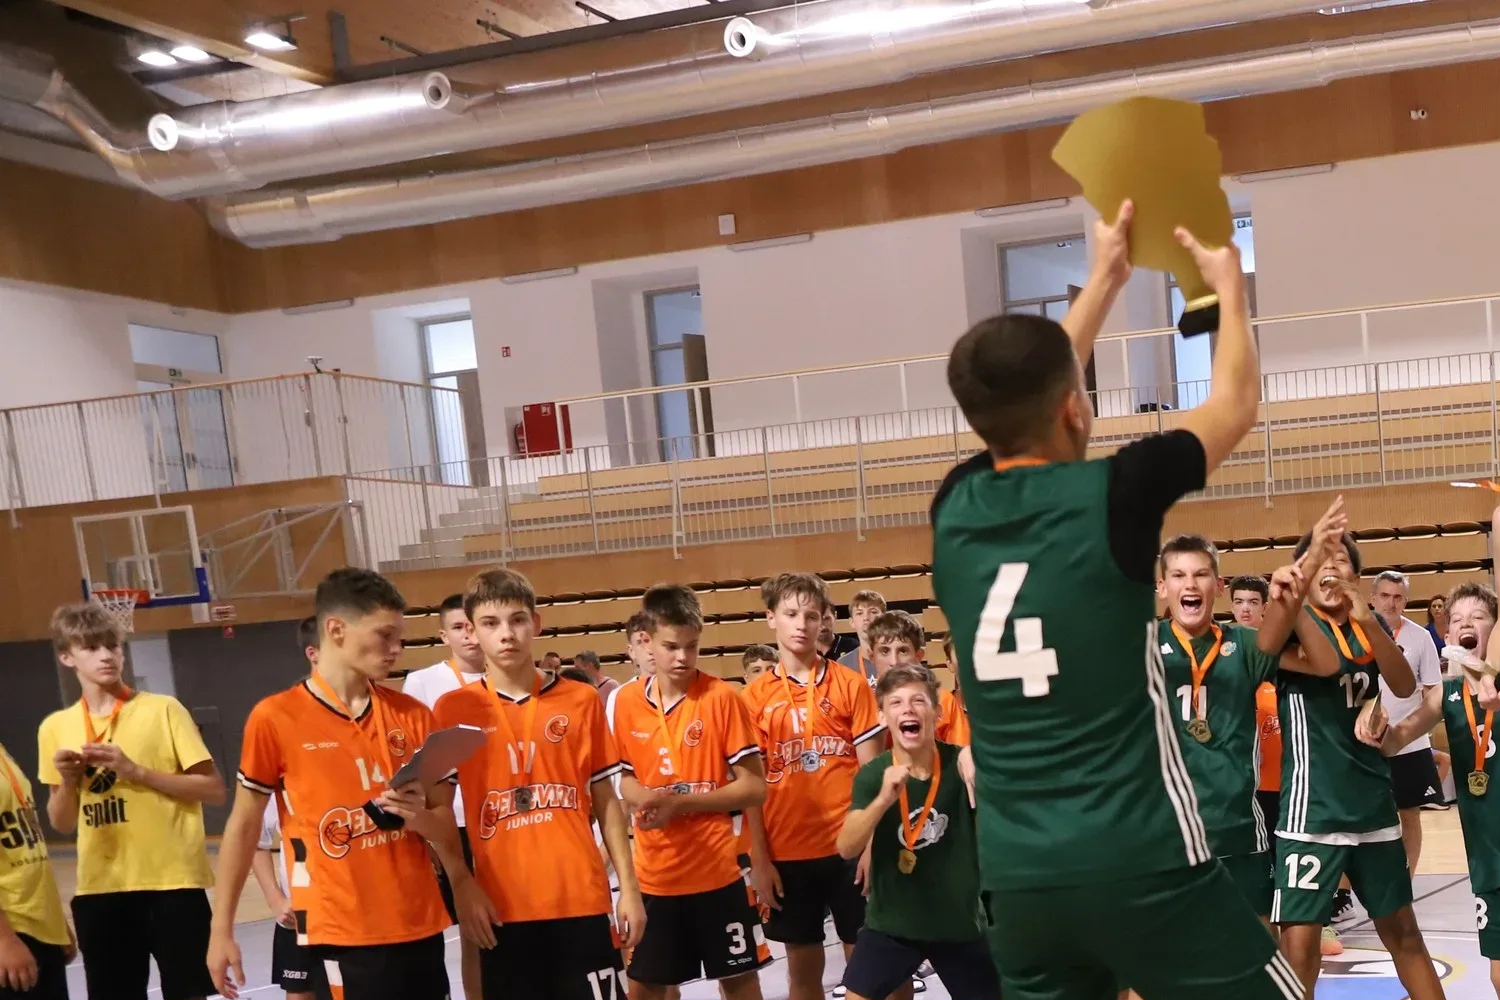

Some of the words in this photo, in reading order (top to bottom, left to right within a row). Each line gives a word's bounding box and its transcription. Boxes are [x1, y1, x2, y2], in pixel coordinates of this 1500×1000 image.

[972, 562, 1060, 697] 4
[1339, 671, 1371, 709] 12
[82, 795, 130, 829] split
[506, 811, 553, 832] JUNIOR
[361, 830, 408, 850] JUNIOR
[1285, 853, 1321, 890] 12
[725, 921, 747, 955] 3
